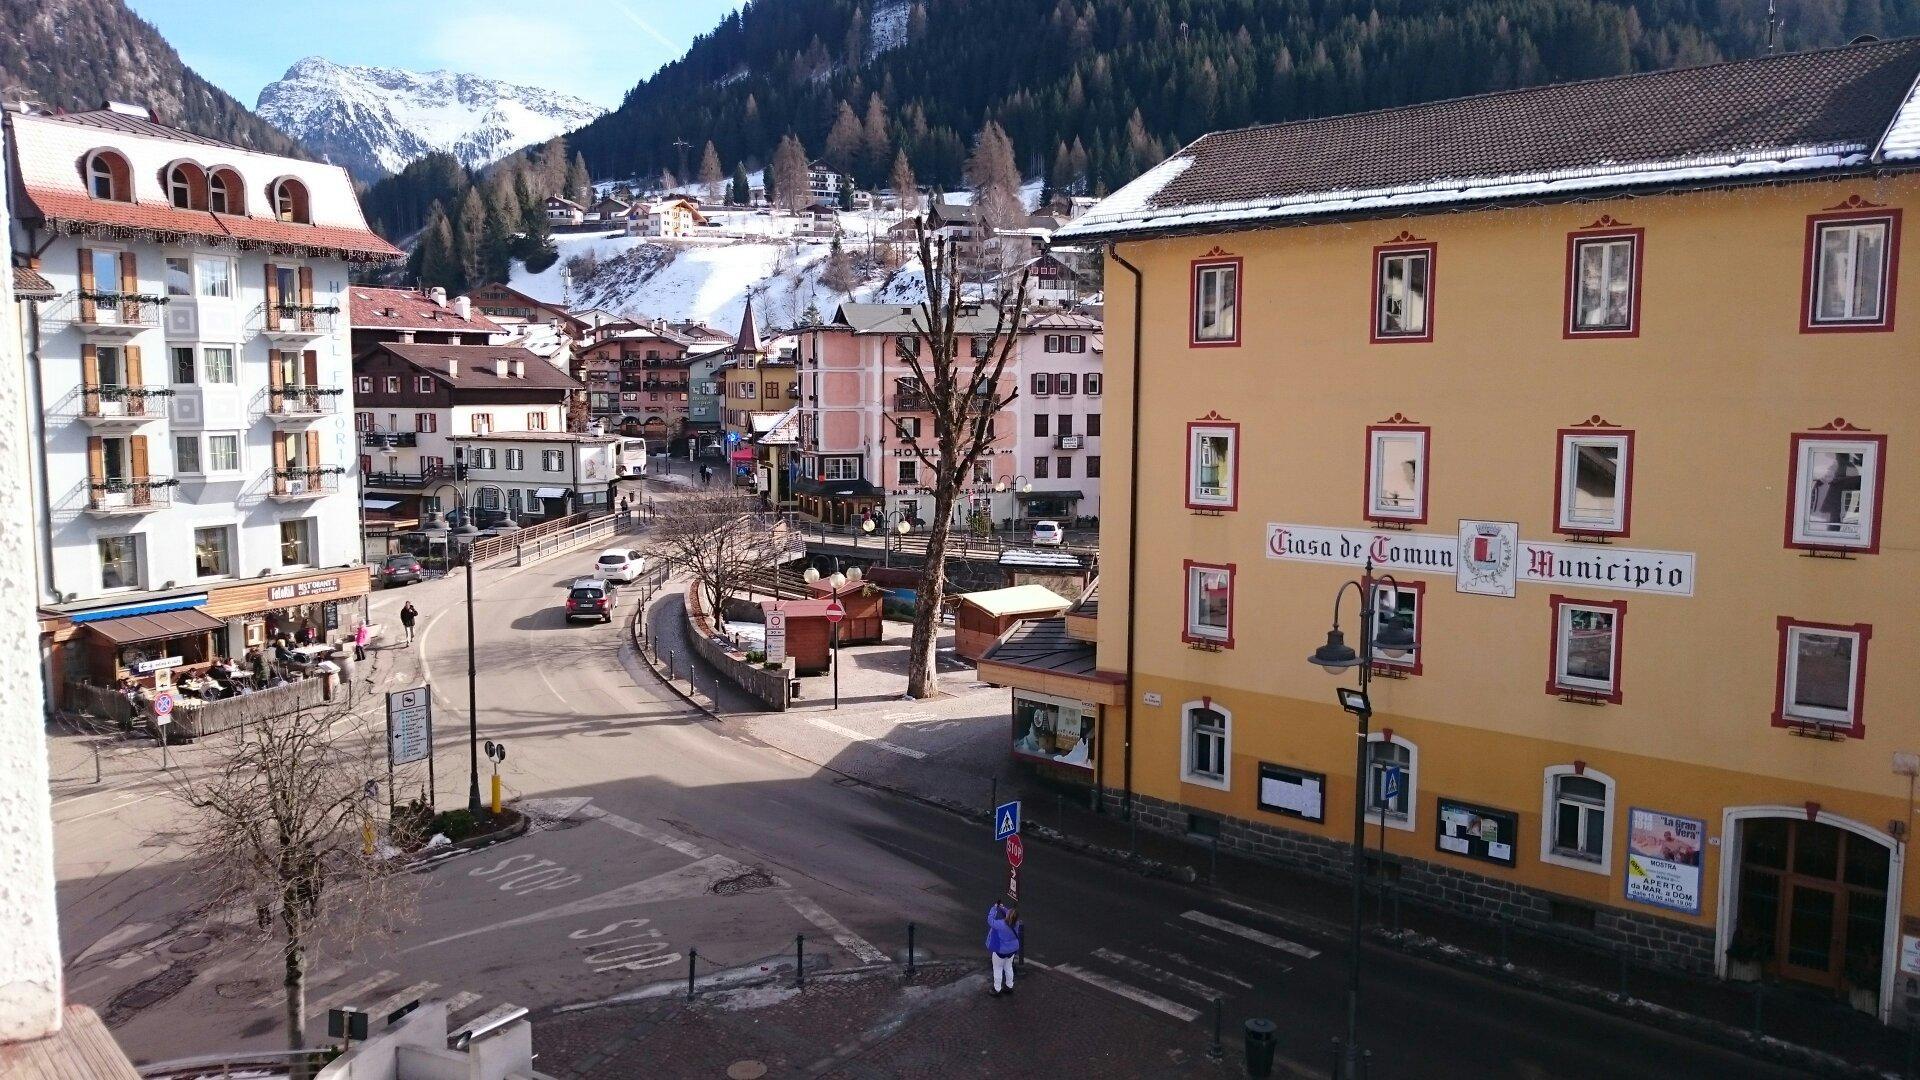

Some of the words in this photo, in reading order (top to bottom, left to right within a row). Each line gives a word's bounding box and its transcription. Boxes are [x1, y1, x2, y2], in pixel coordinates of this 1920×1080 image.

[893, 448, 938, 457] HOTEL
[1340, 533, 1362, 558] de
[1526, 546, 1684, 588] Municipio
[1675, 818, 1697, 831] Gran
[1007, 841, 1022, 858] STOP
[1650, 860, 1677, 871] MOSTRA
[468, 854, 583, 896] STOP
[1644, 878, 1683, 891] APERTO
[1672, 891, 1695, 902] DOM.
[568, 918, 682, 974] STOP
